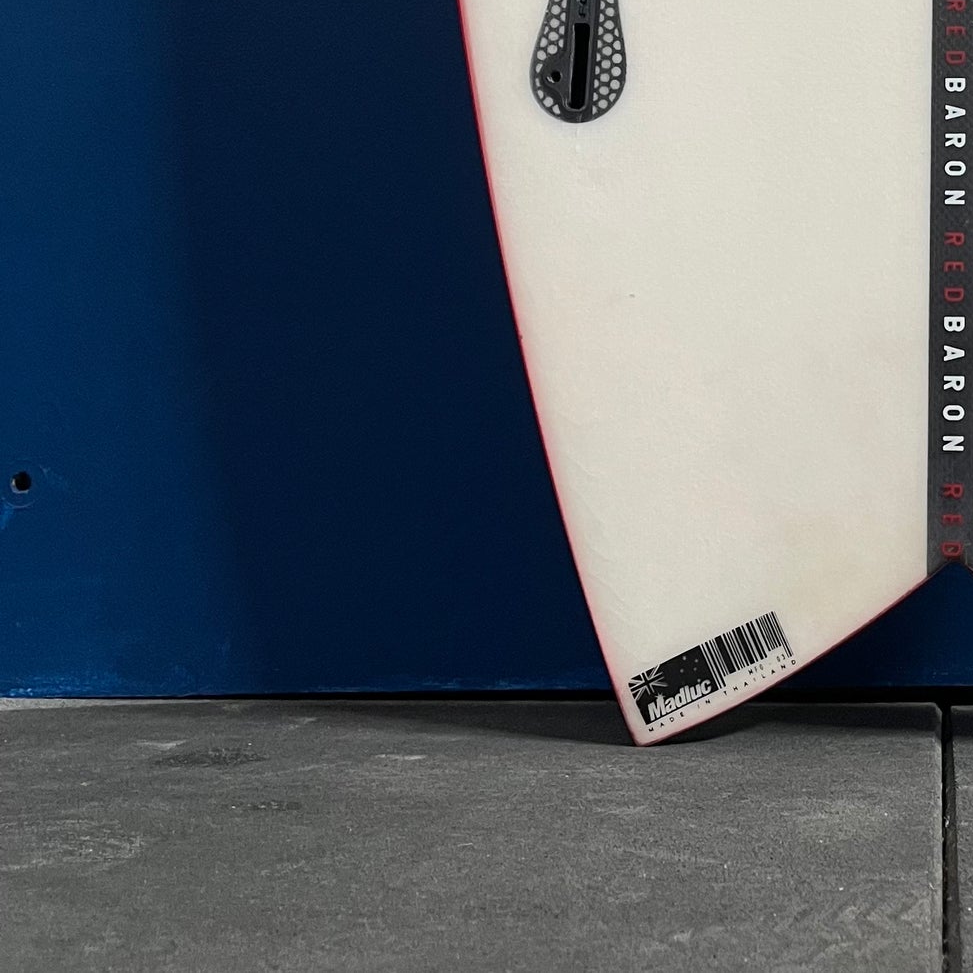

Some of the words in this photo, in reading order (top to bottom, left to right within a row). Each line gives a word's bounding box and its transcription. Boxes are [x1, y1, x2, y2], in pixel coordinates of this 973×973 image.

[941, 483, 964, 558] RED
[646, 678, 713, 722] Madluc
[648, 711, 685, 732] MADE
[723, 659, 797, 695] THAILAND
